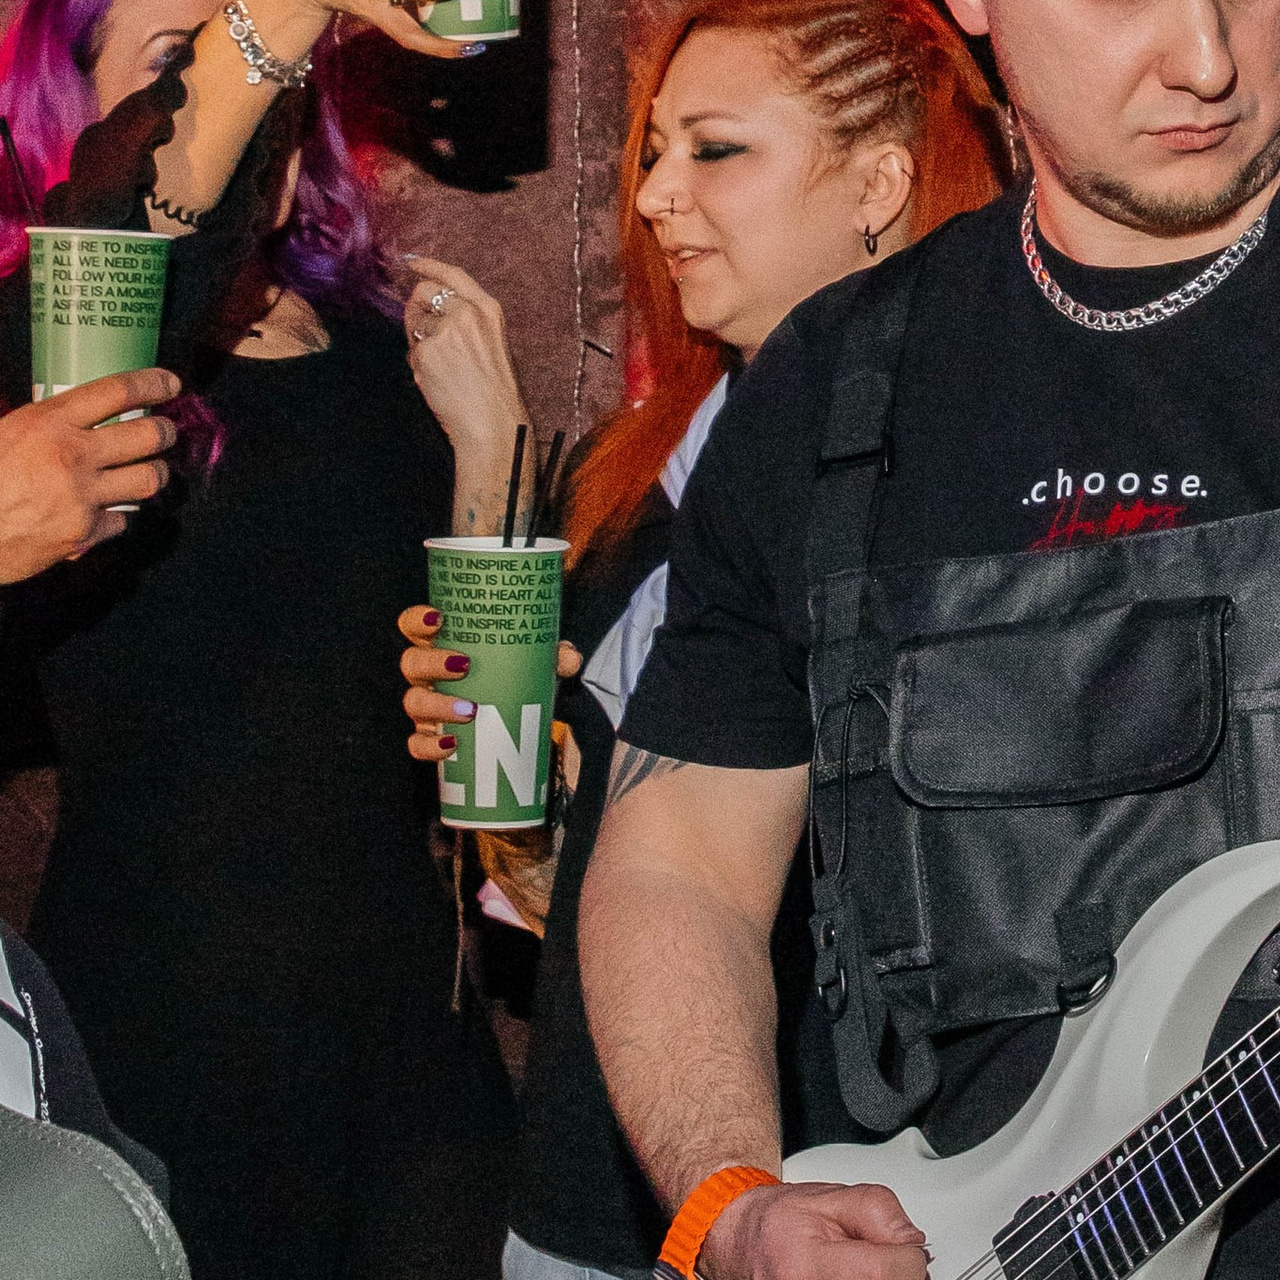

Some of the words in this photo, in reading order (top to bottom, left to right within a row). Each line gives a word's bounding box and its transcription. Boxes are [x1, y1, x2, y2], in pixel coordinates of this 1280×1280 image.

[102, 240, 121, 254] TO
[52, 254, 72, 267] ALL
[78, 255, 101, 268] WE
[104, 257, 140, 269] NEED
[141, 258, 152, 270] IS
[52, 269, 106, 283] FOLLOW
[108, 270, 143, 284] YOUR
[52, 283, 60, 295] A
[91, 285, 103, 297] IS
[105, 286, 115, 298] A
[99, 300, 118, 313] TO
[52, 313, 72, 325] ALL
[77, 314, 98, 326] WE
[101, 315, 134, 328] NEED
[136, 317, 146, 329] IS
[448, 556, 464, 569] TO
[466, 558, 519, 572] INSPIRE
[521, 560, 532, 572] A
[534, 558, 557, 571] LIFE
[451, 572, 482, 585] NEED
[485, 574, 498, 586] IS
[501, 574, 536, 587] LOVE
[454, 586, 487, 600] YOUR
[489, 588, 534, 601] HEART
[535, 589, 553, 601] ALL
[453, 602, 463, 615] A
[462, 602, 523, 616] MOMENT
[450, 615, 464, 628] TO
[466, 617, 516, 631] INSPIRE
[518, 618, 529, 630] A
[531, 616, 551, 629] LIFE
[452, 630, 482, 644] NEED
[484, 633, 498, 644] IS
[500, 633, 535, 646] LOVE
